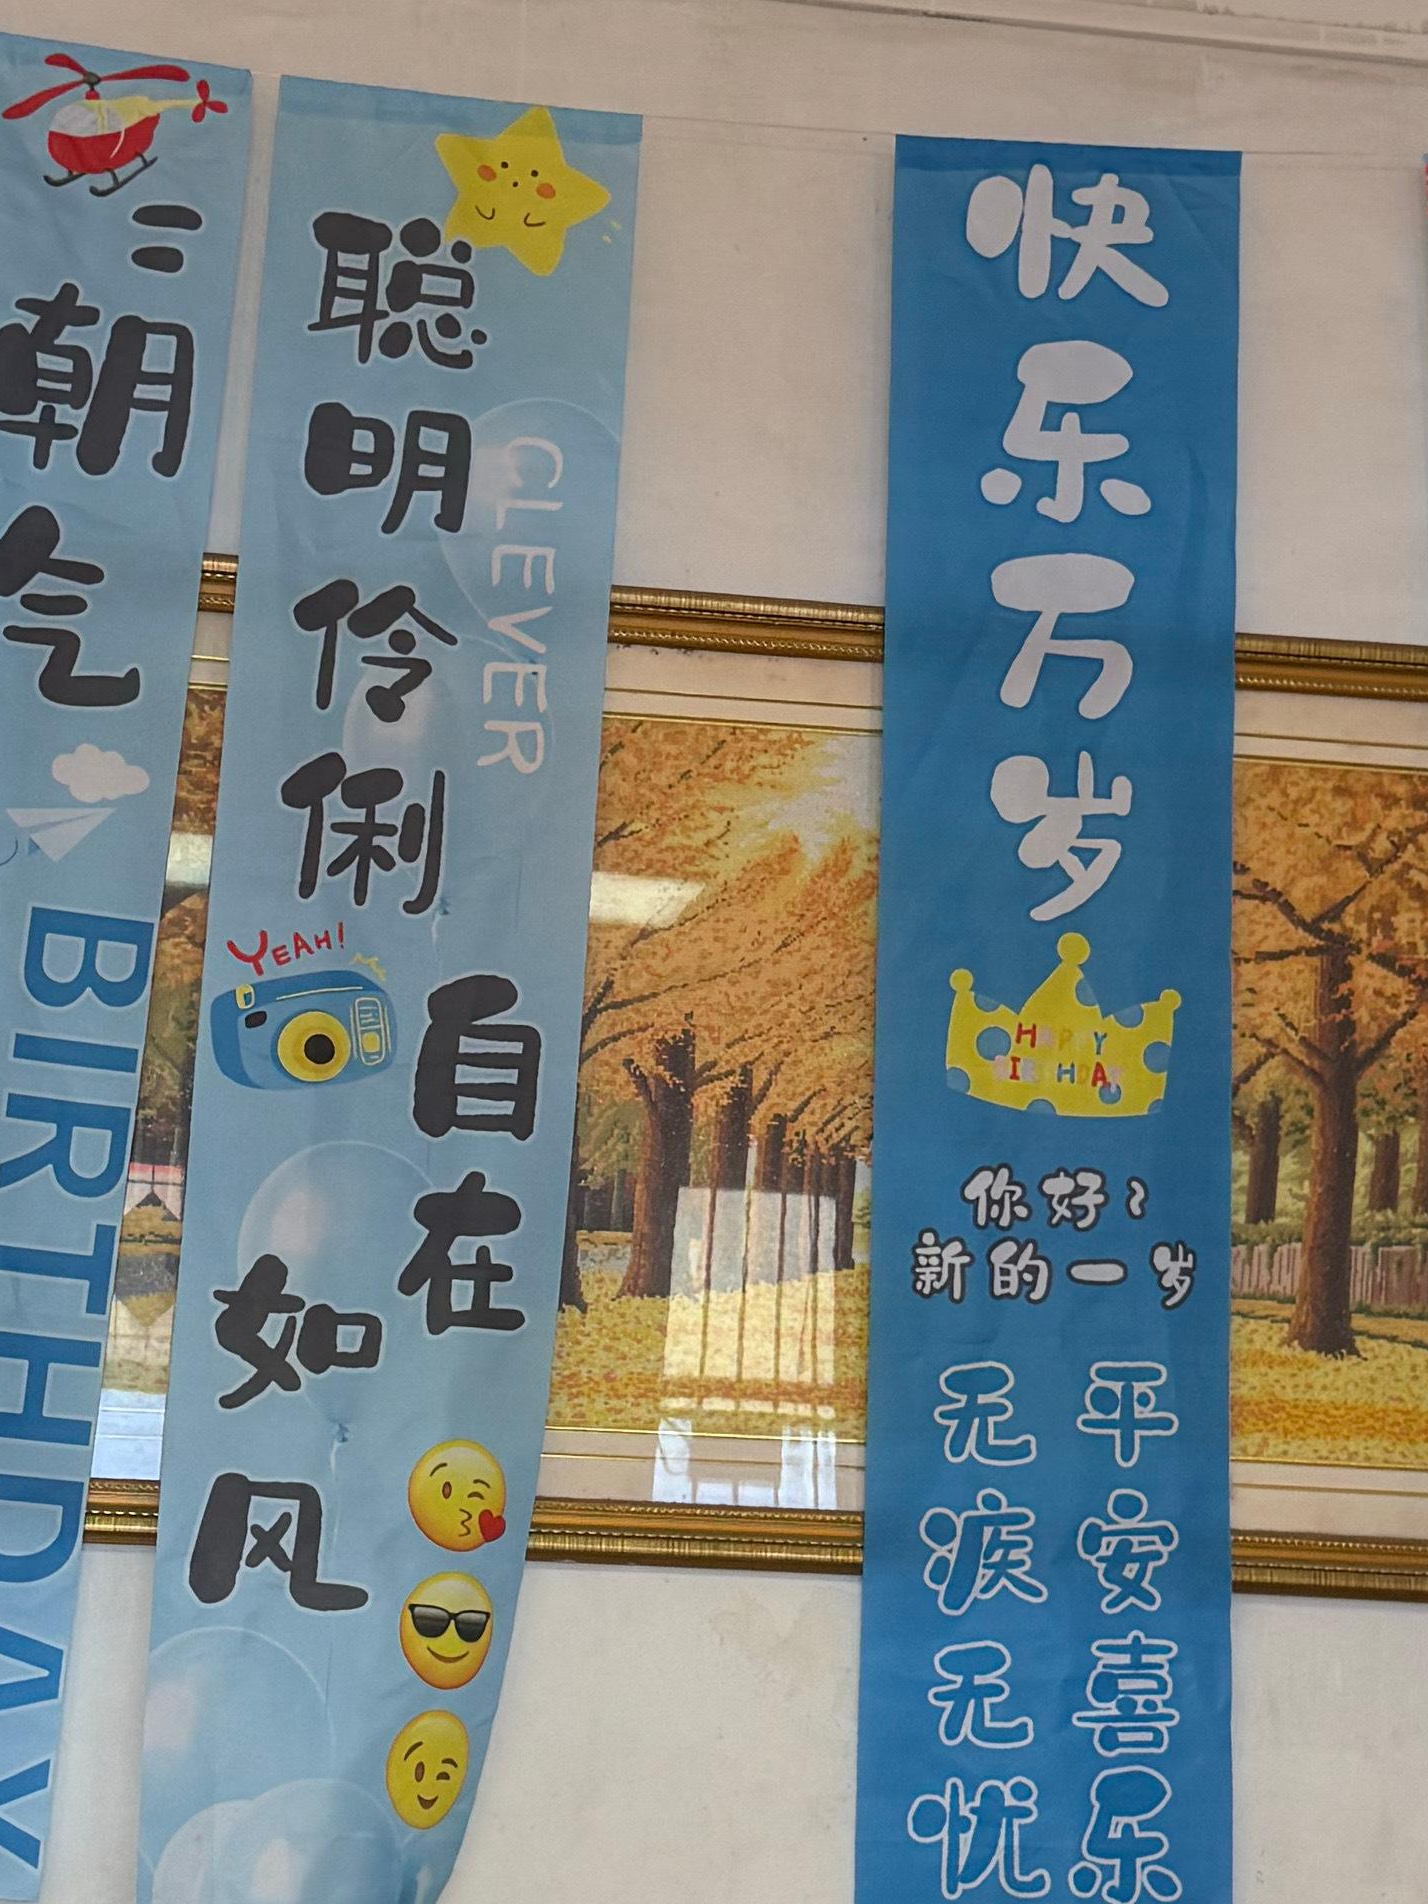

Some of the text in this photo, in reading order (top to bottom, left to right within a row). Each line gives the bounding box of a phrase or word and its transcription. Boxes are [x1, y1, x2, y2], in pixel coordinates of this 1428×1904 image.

[279, 210, 487, 916] 聪明伶俐
[475, 434, 566, 777] CLEVER
[965, 163, 1169, 922] 快乐万岁
[227, 922, 345, 976] YEAH!
[993, 1055, 1124, 1093] BIRHDAY
[398, 975, 542, 1337] 自在
[910, 1229, 1198, 1309] 新的一岁
[188, 1254, 385, 1612] 如风
[907, 1359, 1052, 1900] 无疾无忧
